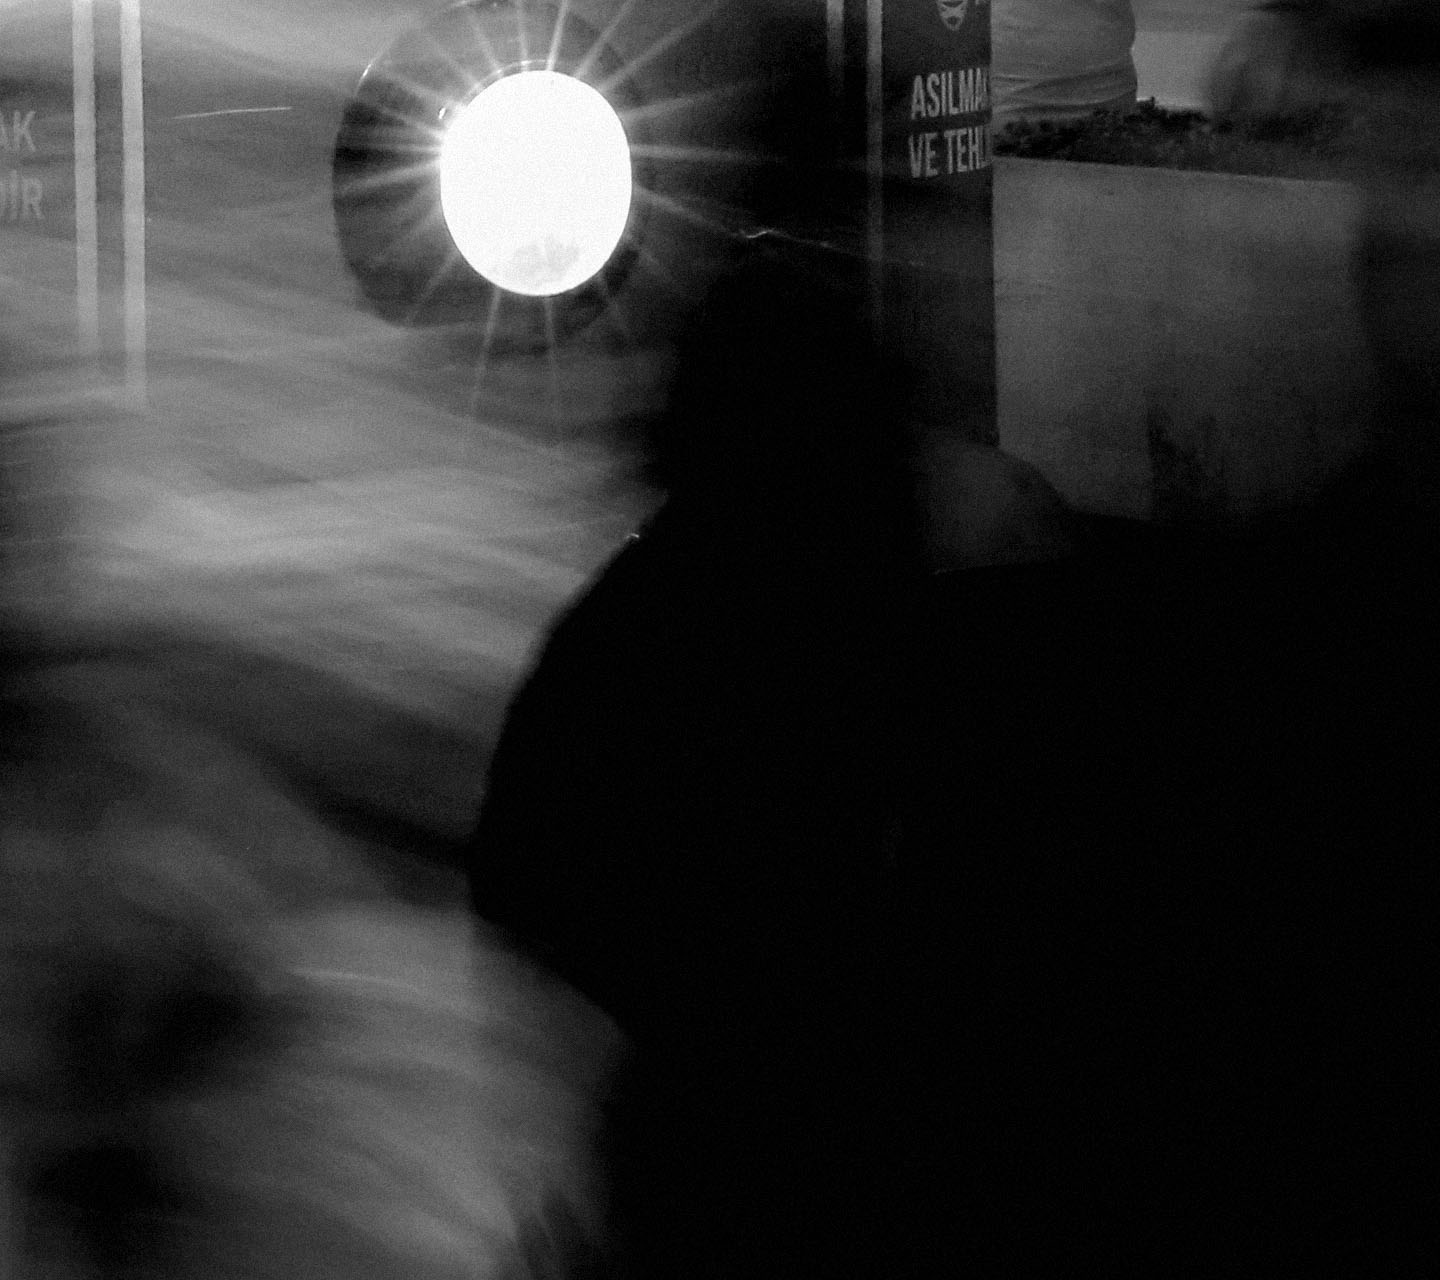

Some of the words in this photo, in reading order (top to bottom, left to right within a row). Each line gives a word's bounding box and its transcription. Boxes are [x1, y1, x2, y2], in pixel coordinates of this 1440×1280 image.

[910, 66, 990, 120] ASILMA
[908, 131, 939, 179] VE
[943, 124, 992, 175] TEHL
